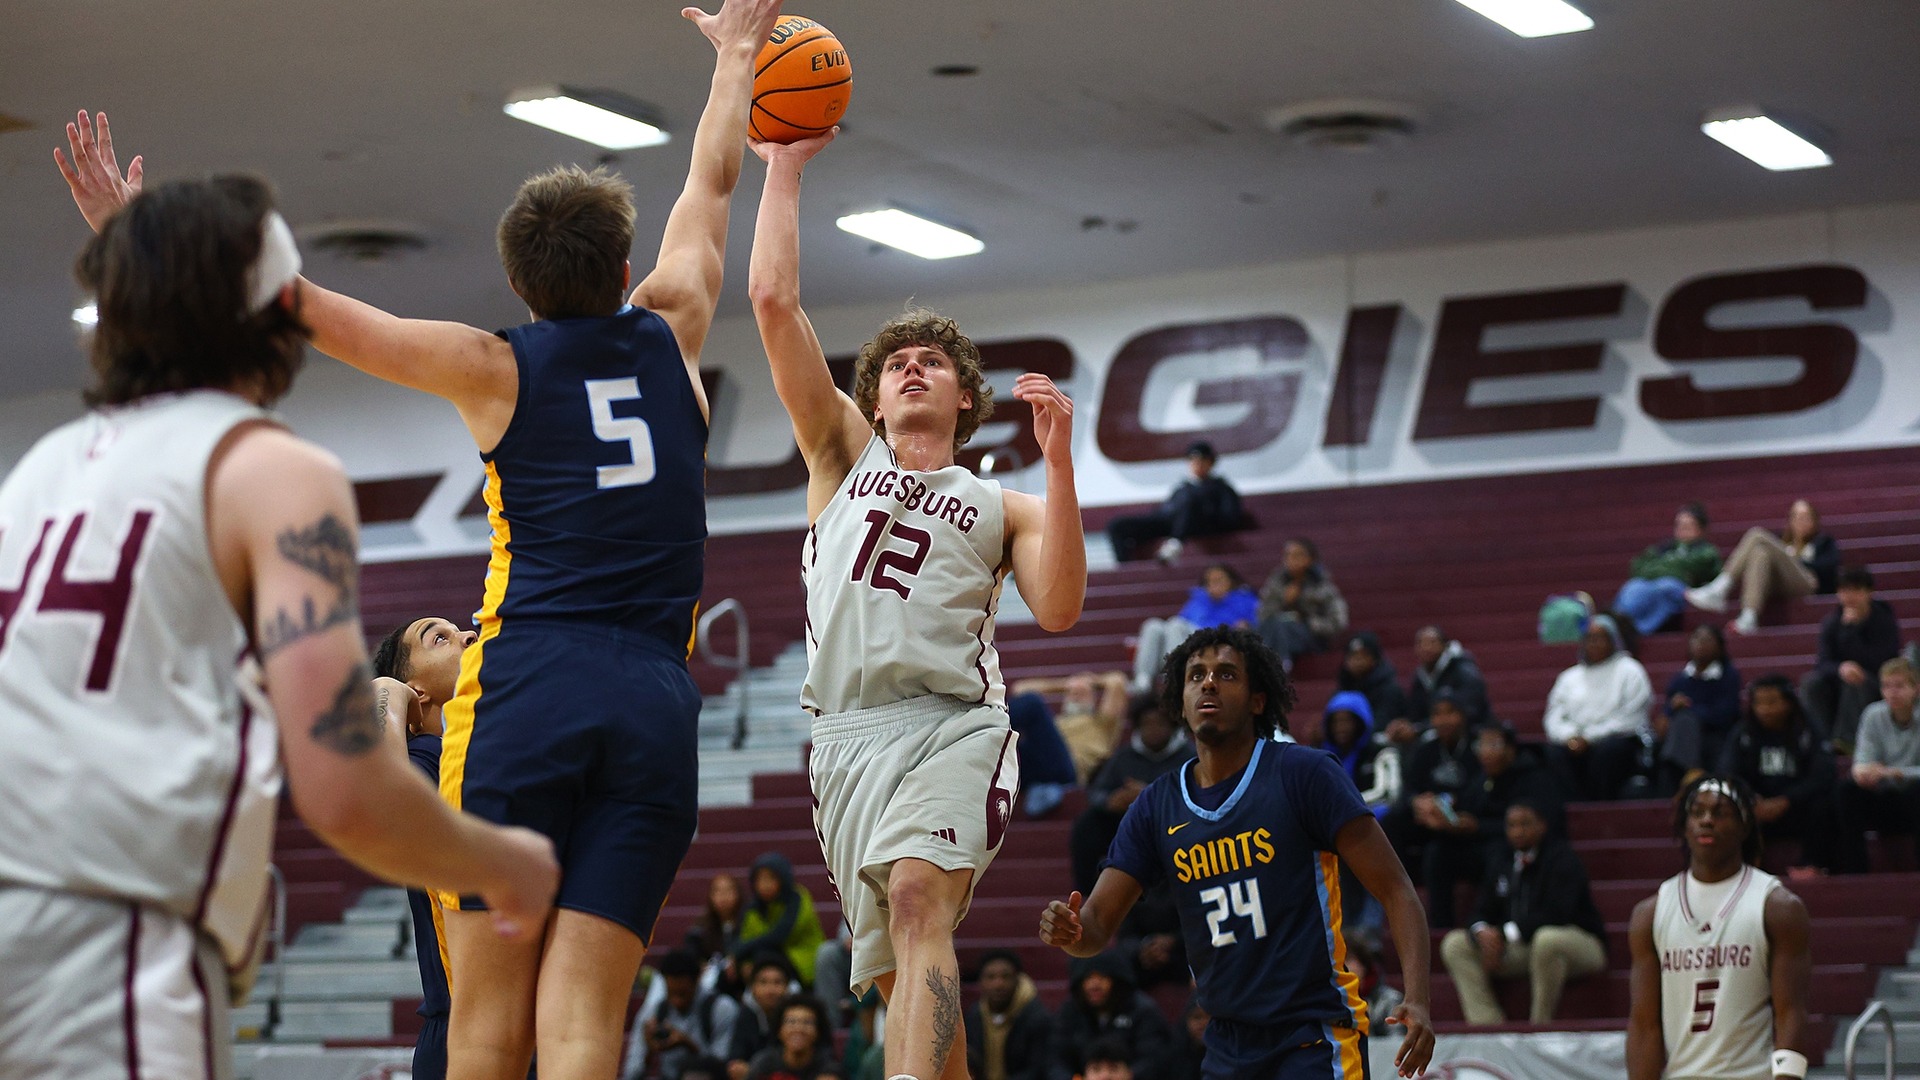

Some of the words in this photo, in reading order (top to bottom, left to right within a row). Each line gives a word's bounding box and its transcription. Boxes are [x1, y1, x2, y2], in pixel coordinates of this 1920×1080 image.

[811, 51, 845, 72] EVO
[456, 264, 1868, 519] GGIES
[584, 376, 657, 490] 5
[848, 469, 979, 535] AUGSBURG
[851, 509, 932, 602] 12
[1173, 827, 1276, 884] SAINTS
[1199, 876, 1269, 948] 24
[1661, 944, 1752, 973] AUGSBURG
[1690, 978, 1721, 1033] 5
